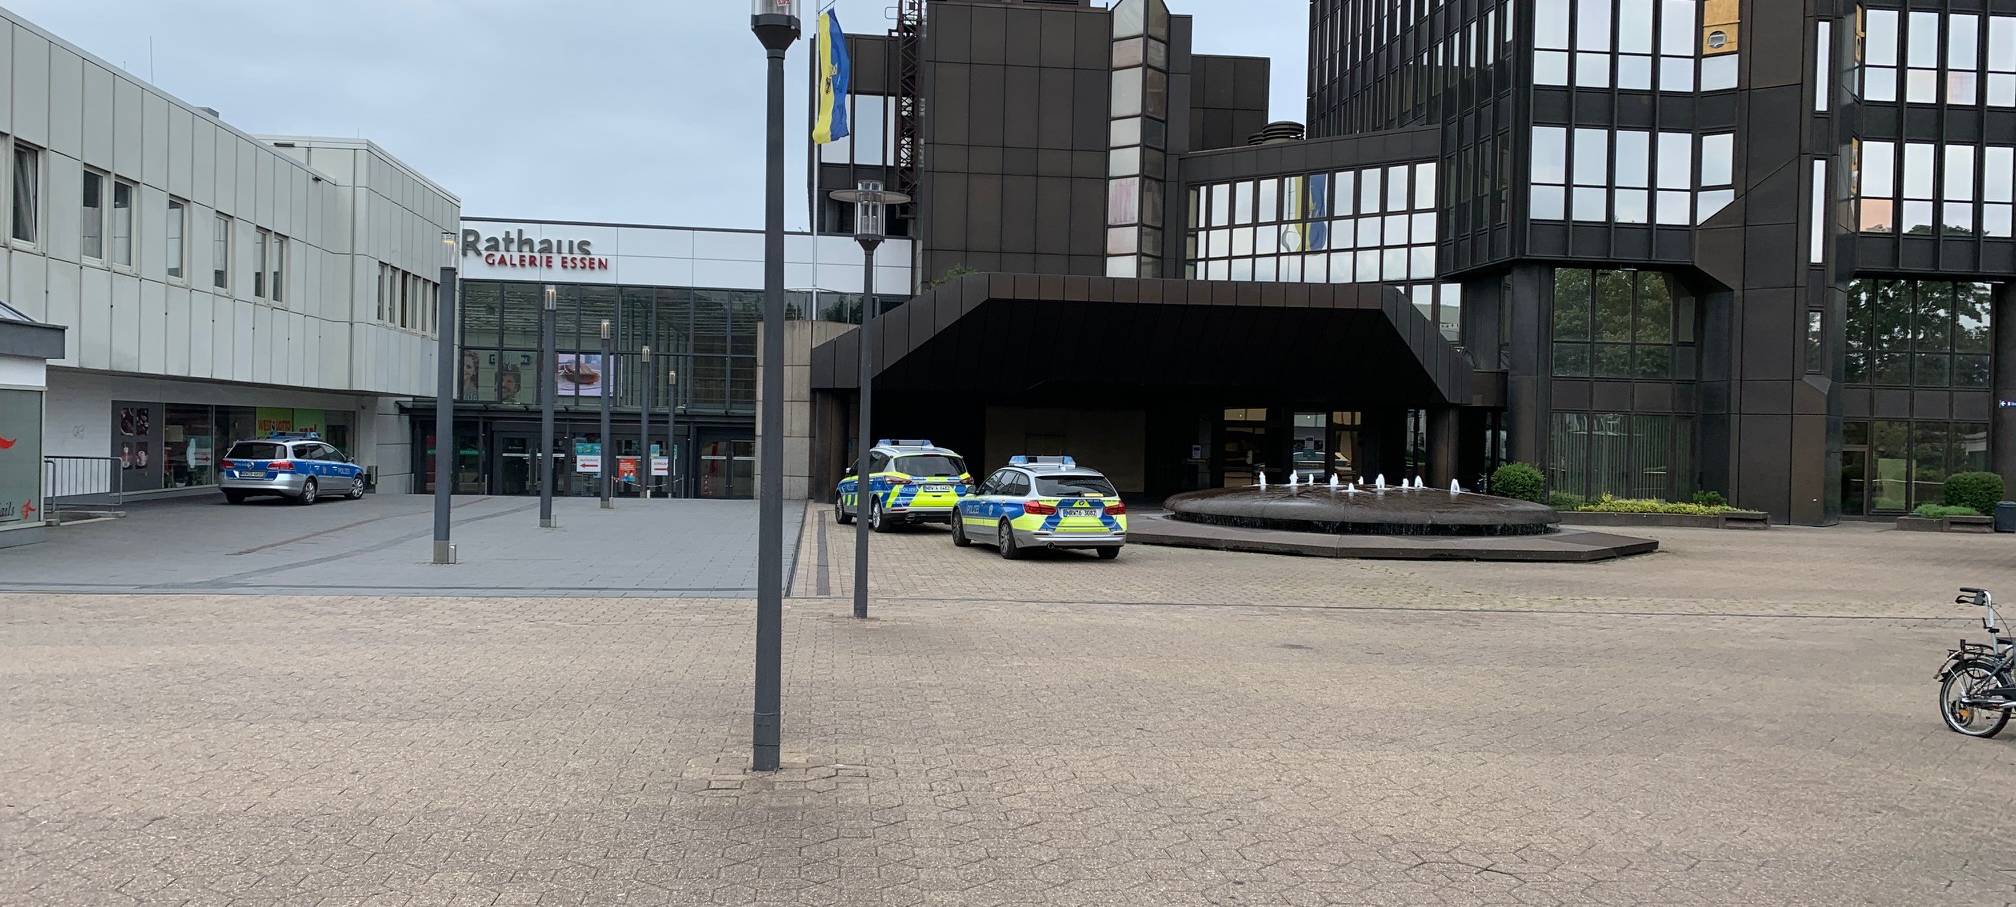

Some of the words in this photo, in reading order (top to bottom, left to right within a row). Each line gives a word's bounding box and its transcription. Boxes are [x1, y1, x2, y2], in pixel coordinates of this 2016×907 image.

[461, 228, 592, 257] Rathaus
[484, 253, 553, 269] GALERIE
[561, 256, 609, 271] ESSEN
